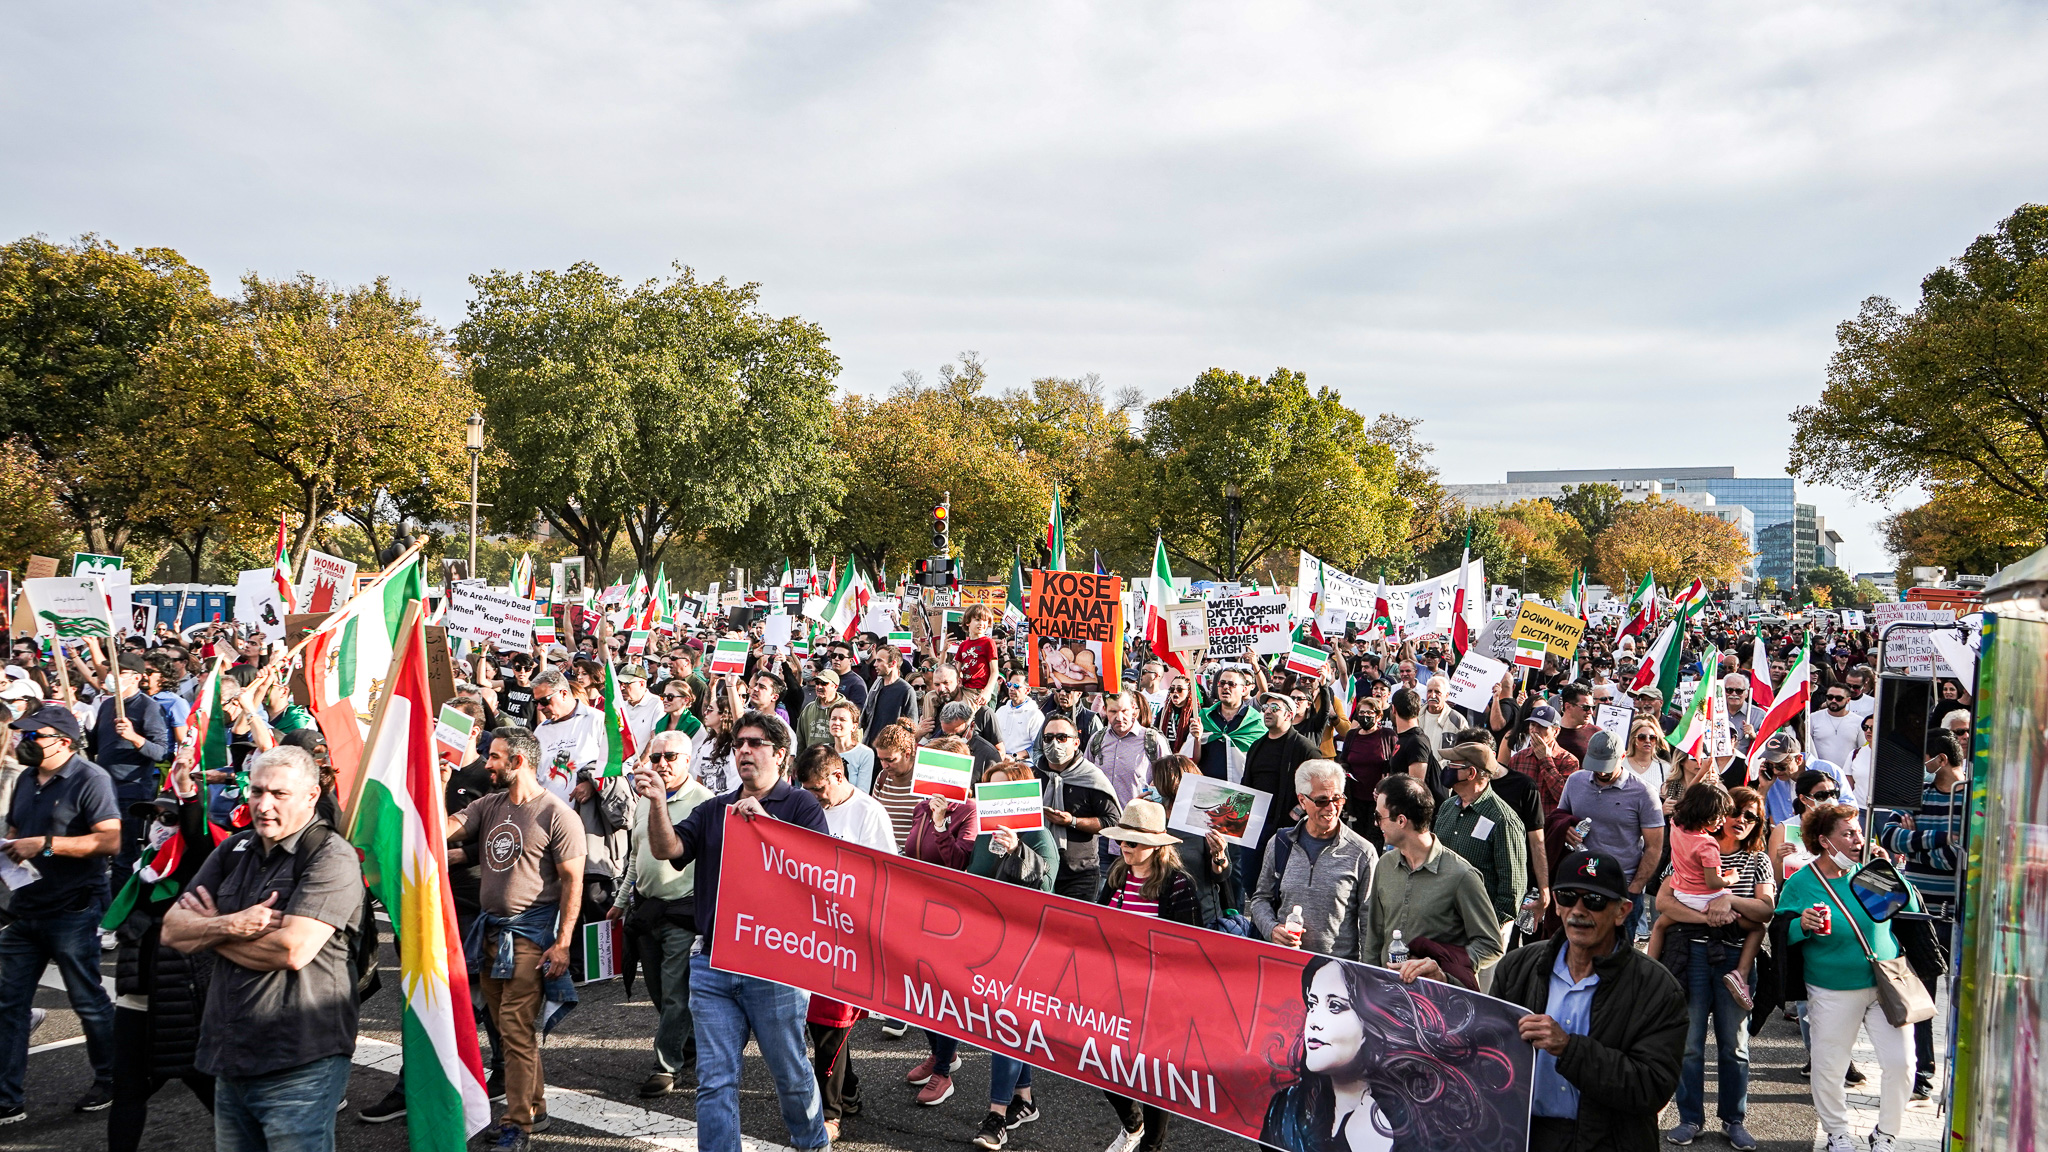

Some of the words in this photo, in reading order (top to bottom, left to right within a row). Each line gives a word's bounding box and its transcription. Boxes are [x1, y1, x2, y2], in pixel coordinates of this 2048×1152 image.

[314, 556, 346, 575] WOMAN
[324, 569, 345, 579] FREEDOM
[1042, 573, 1111, 599] KOSE
[457, 588, 468, 597] We
[469, 591, 484, 601] Are
[483, 594, 511, 608] Already
[511, 600, 532, 612] Dead
[1207, 598, 1244, 609] WHEN
[1876, 603, 1899, 613] KILLING
[1899, 602, 1927, 611] CHILDREN
[453, 603, 474, 615] When
[474, 603, 487, 613] We
[483, 612, 504, 625] Keep
[504, 613, 531, 625] Silence
[1038, 595, 1119, 624] NANAT
[1206, 603, 1287, 619] DICTATORSHIP
[1876, 611, 1904, 620] ATTACKIN
[1905, 612, 1928, 621] IRAN
[1930, 612, 1950, 622] 2022
[449, 622, 469, 633] Over
[473, 626, 502, 639] Murder
[501, 627, 511, 635] of
[511, 629, 525, 639] the
[1028, 617, 1114, 643] KHAMENEI
[1207, 619, 1218, 627] IS
[1219, 618, 1229, 627] A
[1208, 623, 1280, 636] REVOLUTION
[1521, 609, 1554, 628] DOWN
[1554, 621, 1580, 638] WITH
[500, 638, 527, 650] Innocent
[1209, 634, 1259, 645] BECOMES
[1520, 624, 1570, 652] DICTATOR
[1906, 636, 1926, 646] TAKE
[1918, 664, 1931, 672] THE
[1935, 664, 1953, 672] WORL
[507, 702, 521, 713] LIFE
[980, 808, 1003, 816] Woman,
[1003, 807, 1016, 815] Life,
[761, 841, 856, 899] Woman
[812, 894, 855, 935] Life
[735, 913, 858, 973] Freedom
[972, 974, 1013, 1002] SAY
[1016, 987, 1062, 1020] HER
[1067, 1005, 1132, 1041] NAME
[903, 974, 1056, 1063] MAHSA
[1078, 1037, 1218, 1114] AMINI
